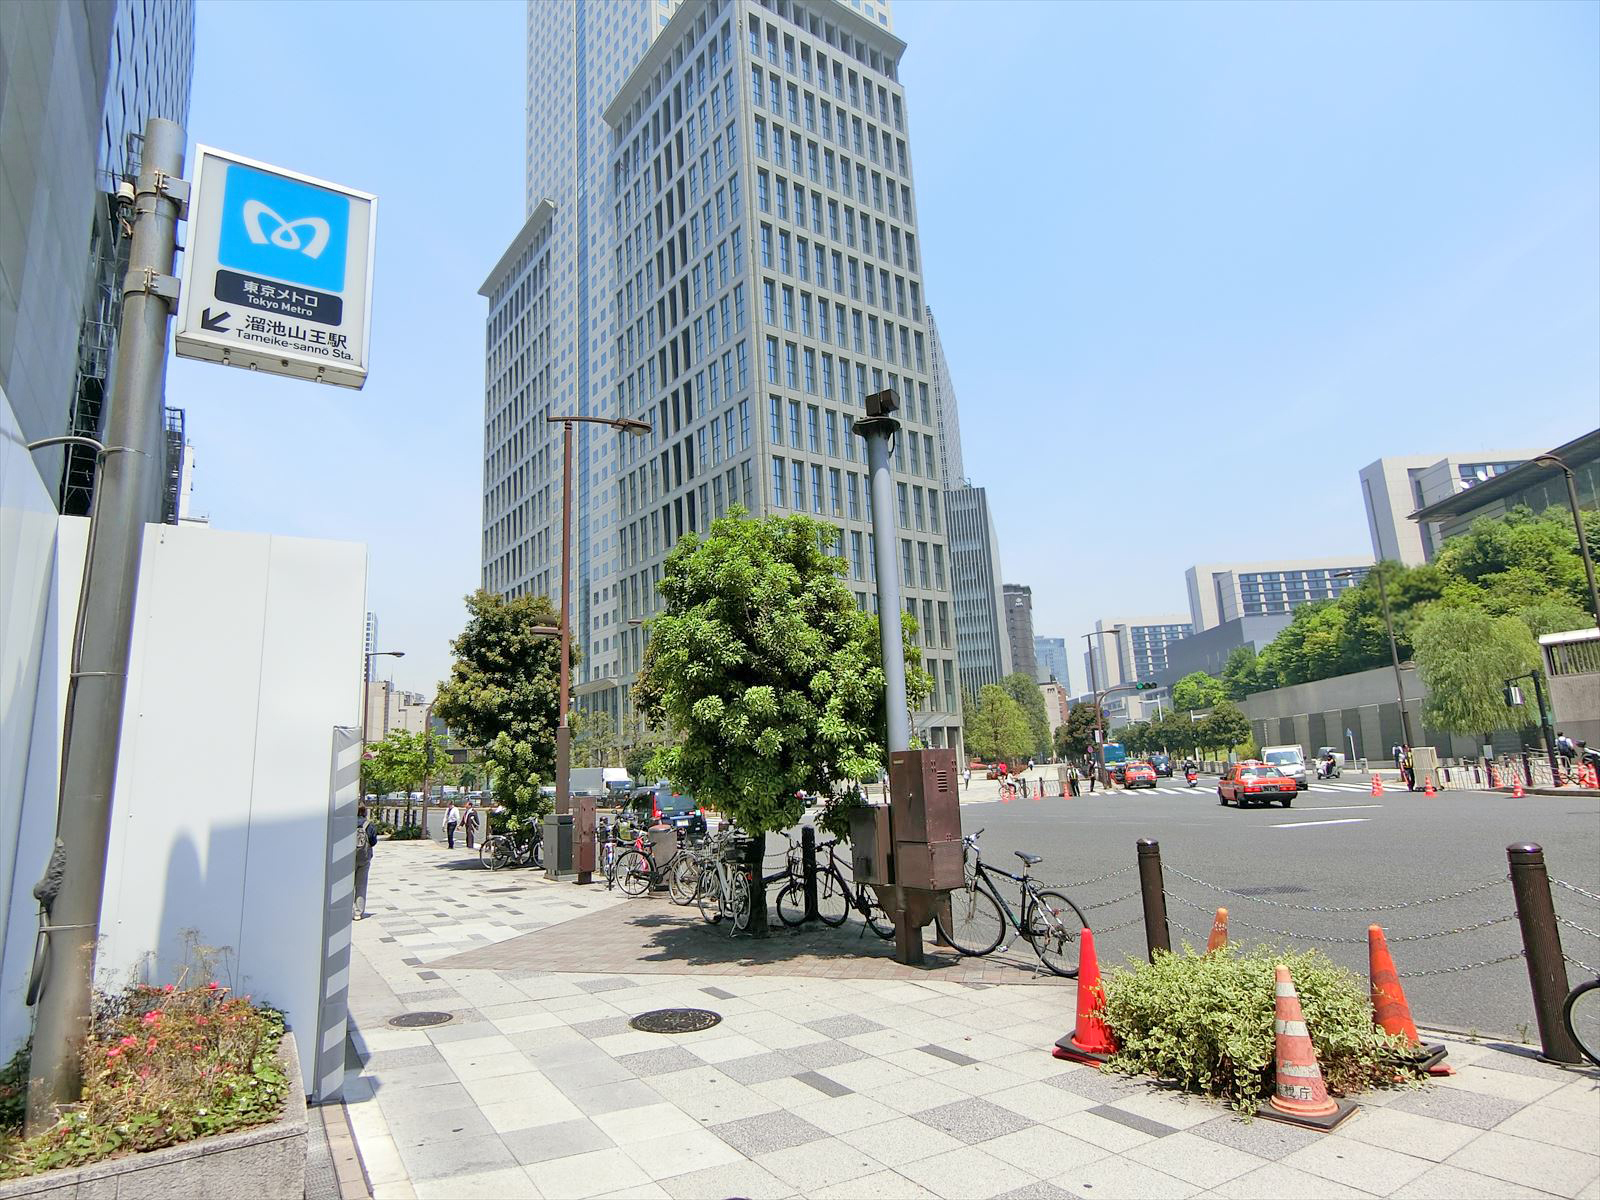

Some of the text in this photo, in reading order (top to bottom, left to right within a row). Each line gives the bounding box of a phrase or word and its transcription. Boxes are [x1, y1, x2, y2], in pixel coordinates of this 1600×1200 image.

[243, 280, 318, 307] 東京メトロ
[247, 294, 313, 316] Tokyo Metro
[245, 314, 347, 350] 溜池山王駅
[332, 349, 354, 361] Sta.
